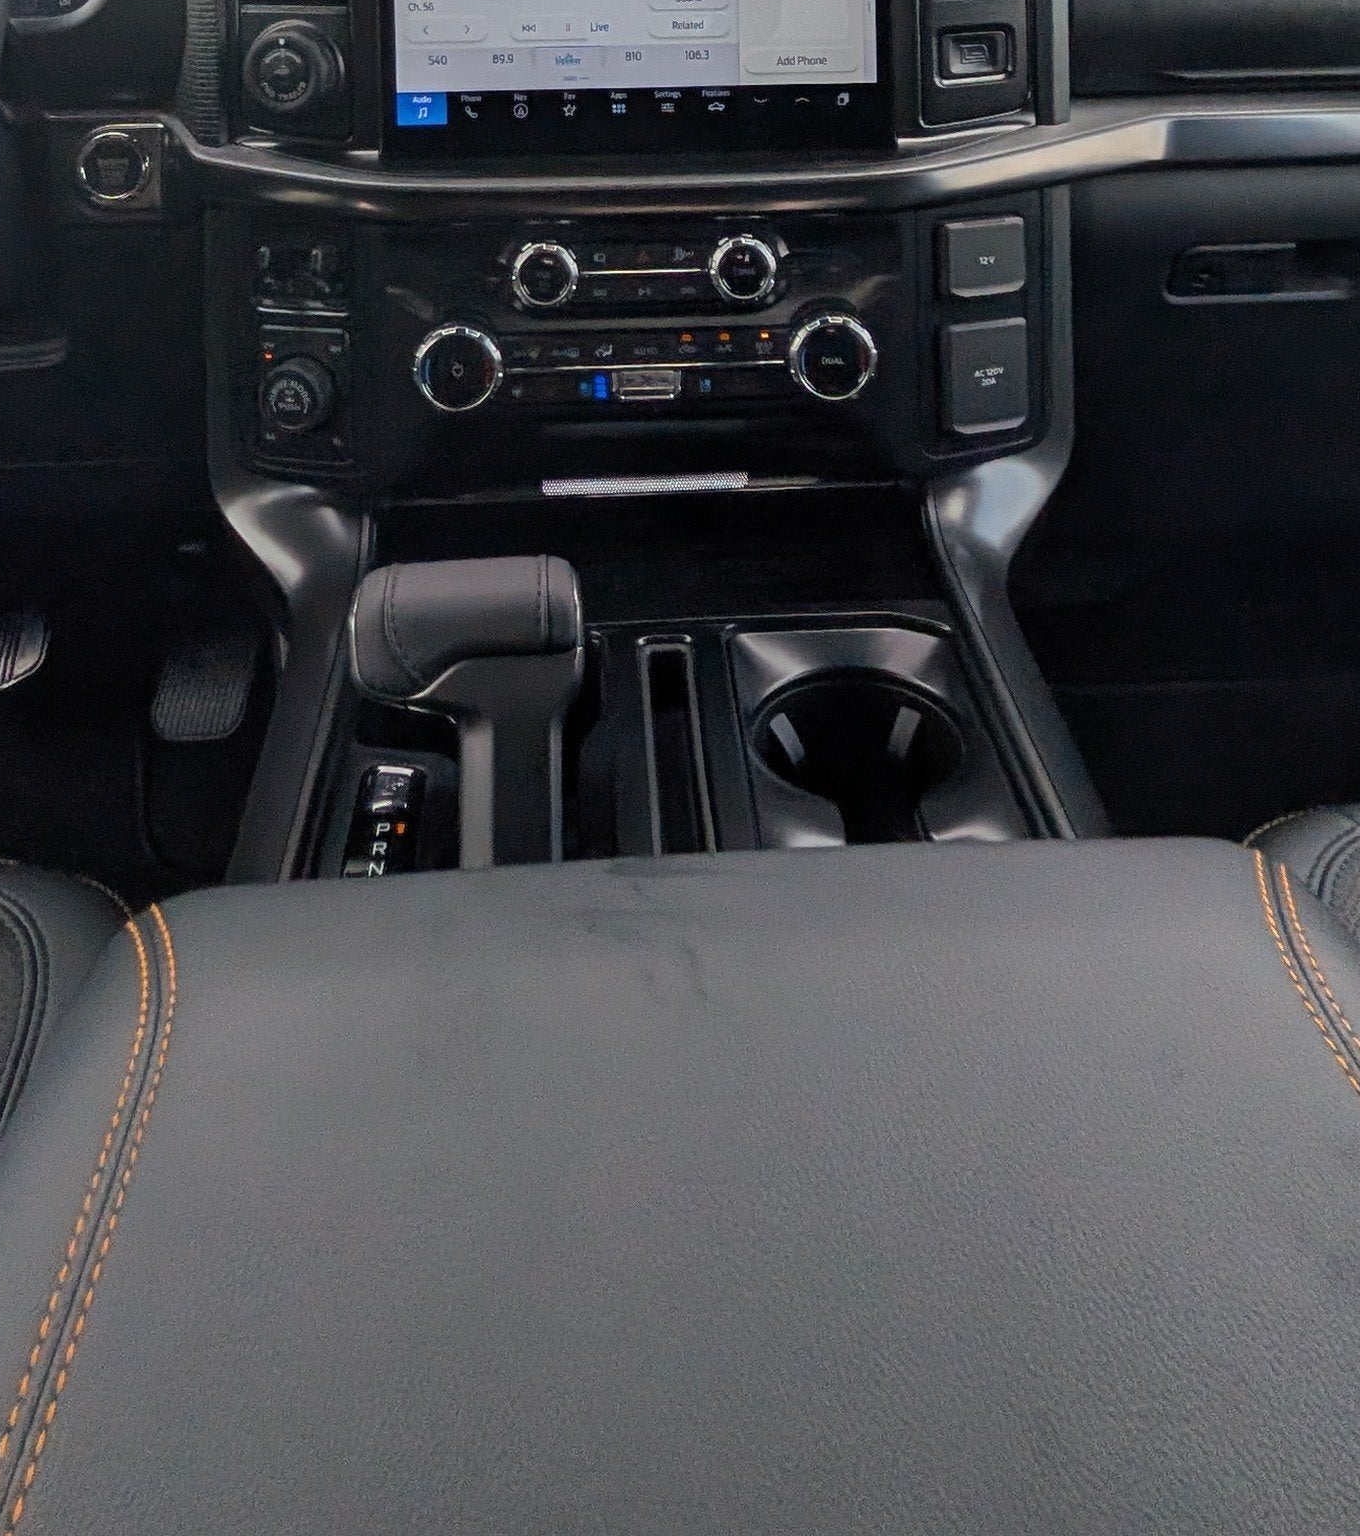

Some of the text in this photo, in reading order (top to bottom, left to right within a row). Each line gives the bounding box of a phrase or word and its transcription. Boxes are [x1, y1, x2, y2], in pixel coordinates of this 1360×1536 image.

[590, 22, 610, 32] Live
[428, 55, 448, 66] 540
[492, 53, 514, 64] 89.9
[625, 51, 642, 61] 810
[776, 56, 796, 66] Add
[979, 255, 996, 265] 12V
[375, 822, 390, 837] P
[372, 842, 388, 856] R
[368, 862, 385, 877] N
